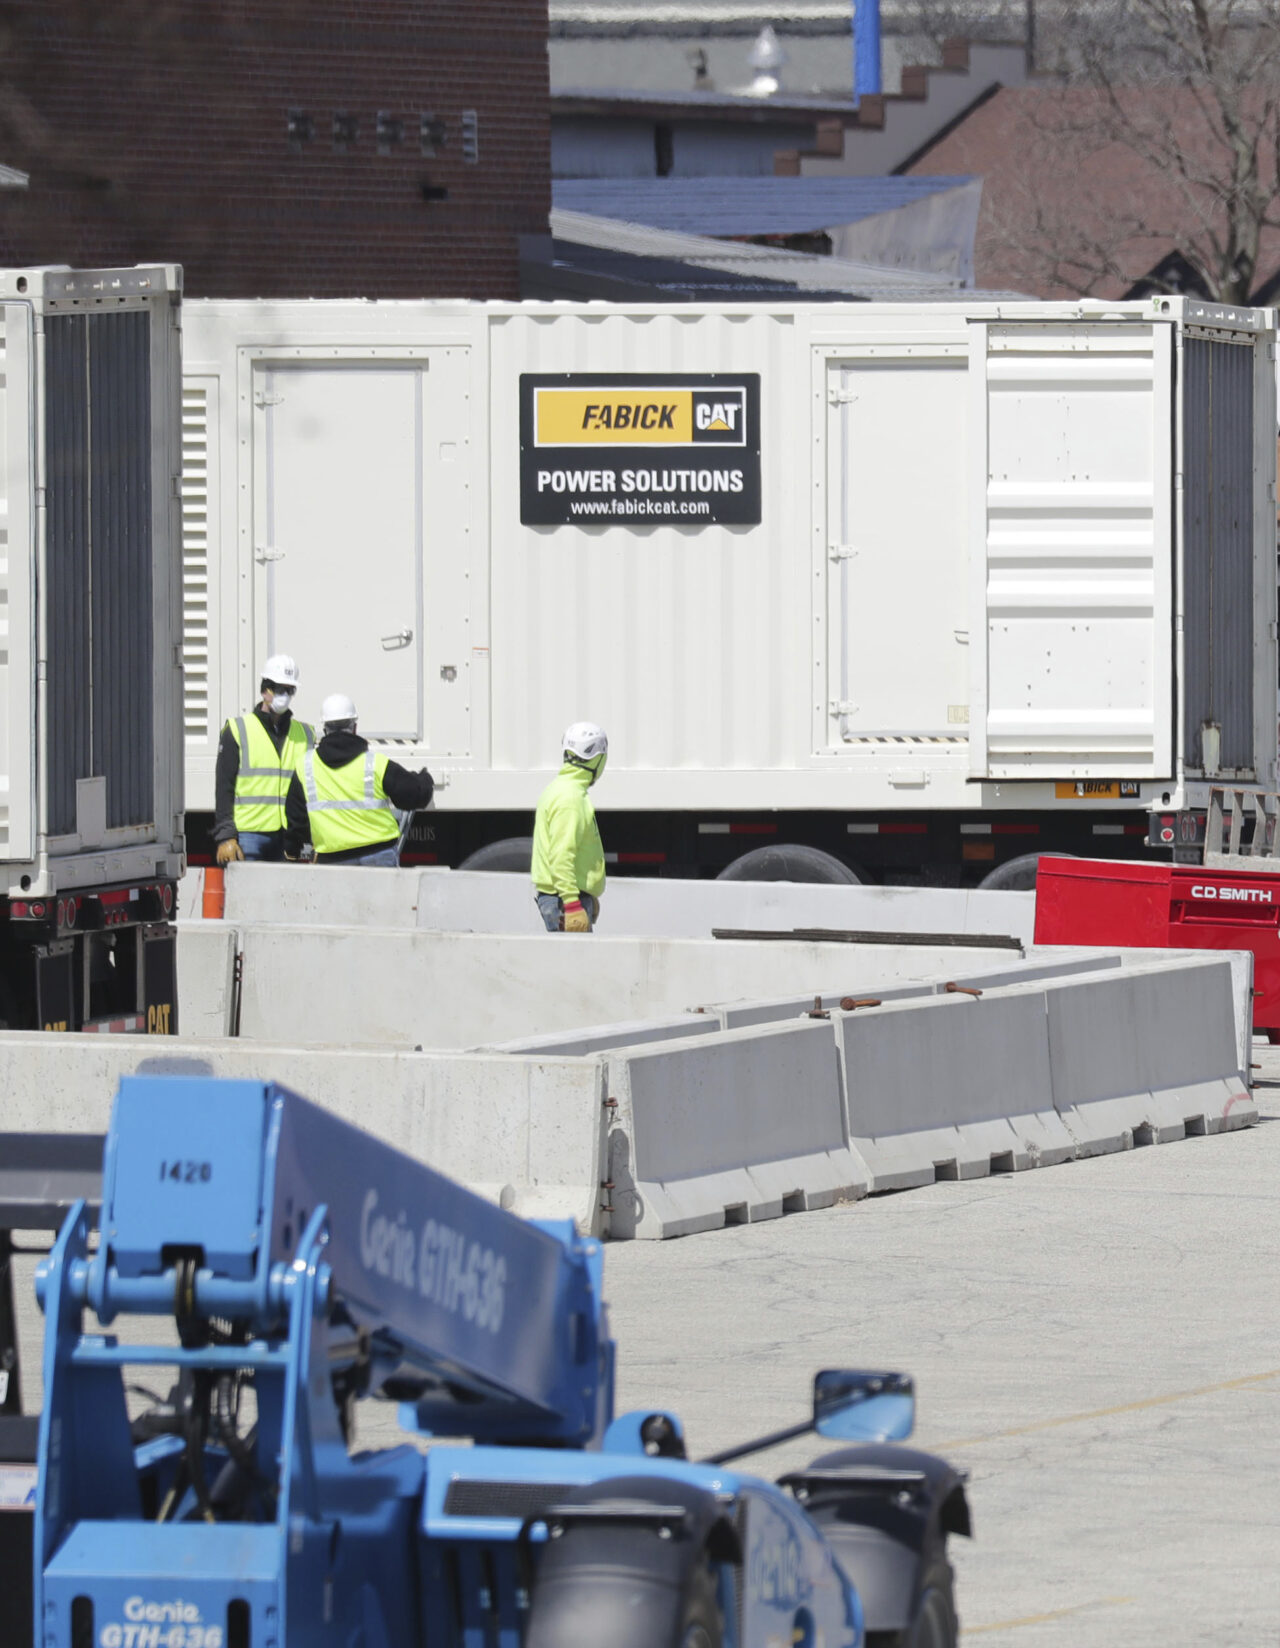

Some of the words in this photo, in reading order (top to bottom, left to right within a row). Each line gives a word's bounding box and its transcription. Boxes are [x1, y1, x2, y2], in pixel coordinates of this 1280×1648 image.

[582, 405, 677, 429] FABICK
[696, 402, 741, 431] CAT
[538, 470, 616, 492] POWER
[621, 469, 743, 492] SOLUTIONS
[571, 500, 710, 514] www.fabickcat.com
[1219, 888, 1272, 902] SMITH
[361, 1188, 415, 1288] Genie
[419, 1219, 506, 1334] GTH-636
[124, 1596, 202, 1623] Genie
[101, 1624, 223, 1648] GTH-636
